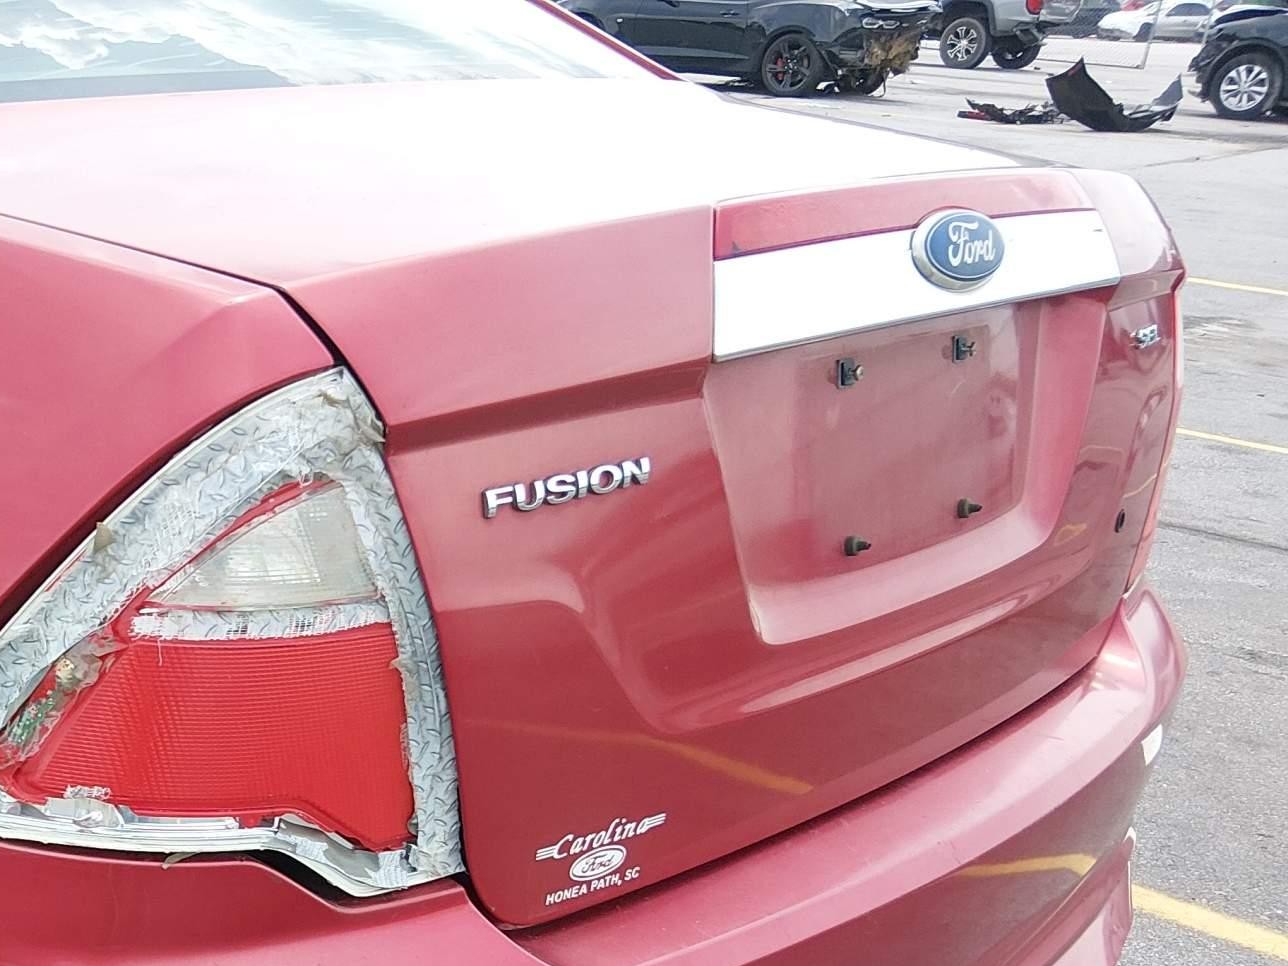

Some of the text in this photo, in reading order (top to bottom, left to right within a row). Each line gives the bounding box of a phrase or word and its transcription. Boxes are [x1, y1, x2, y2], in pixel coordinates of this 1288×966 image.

[948, 221, 996, 267] Ford
[482, 456, 651, 518] FUSION
[544, 866, 641, 906] HONEA PATH, SC
